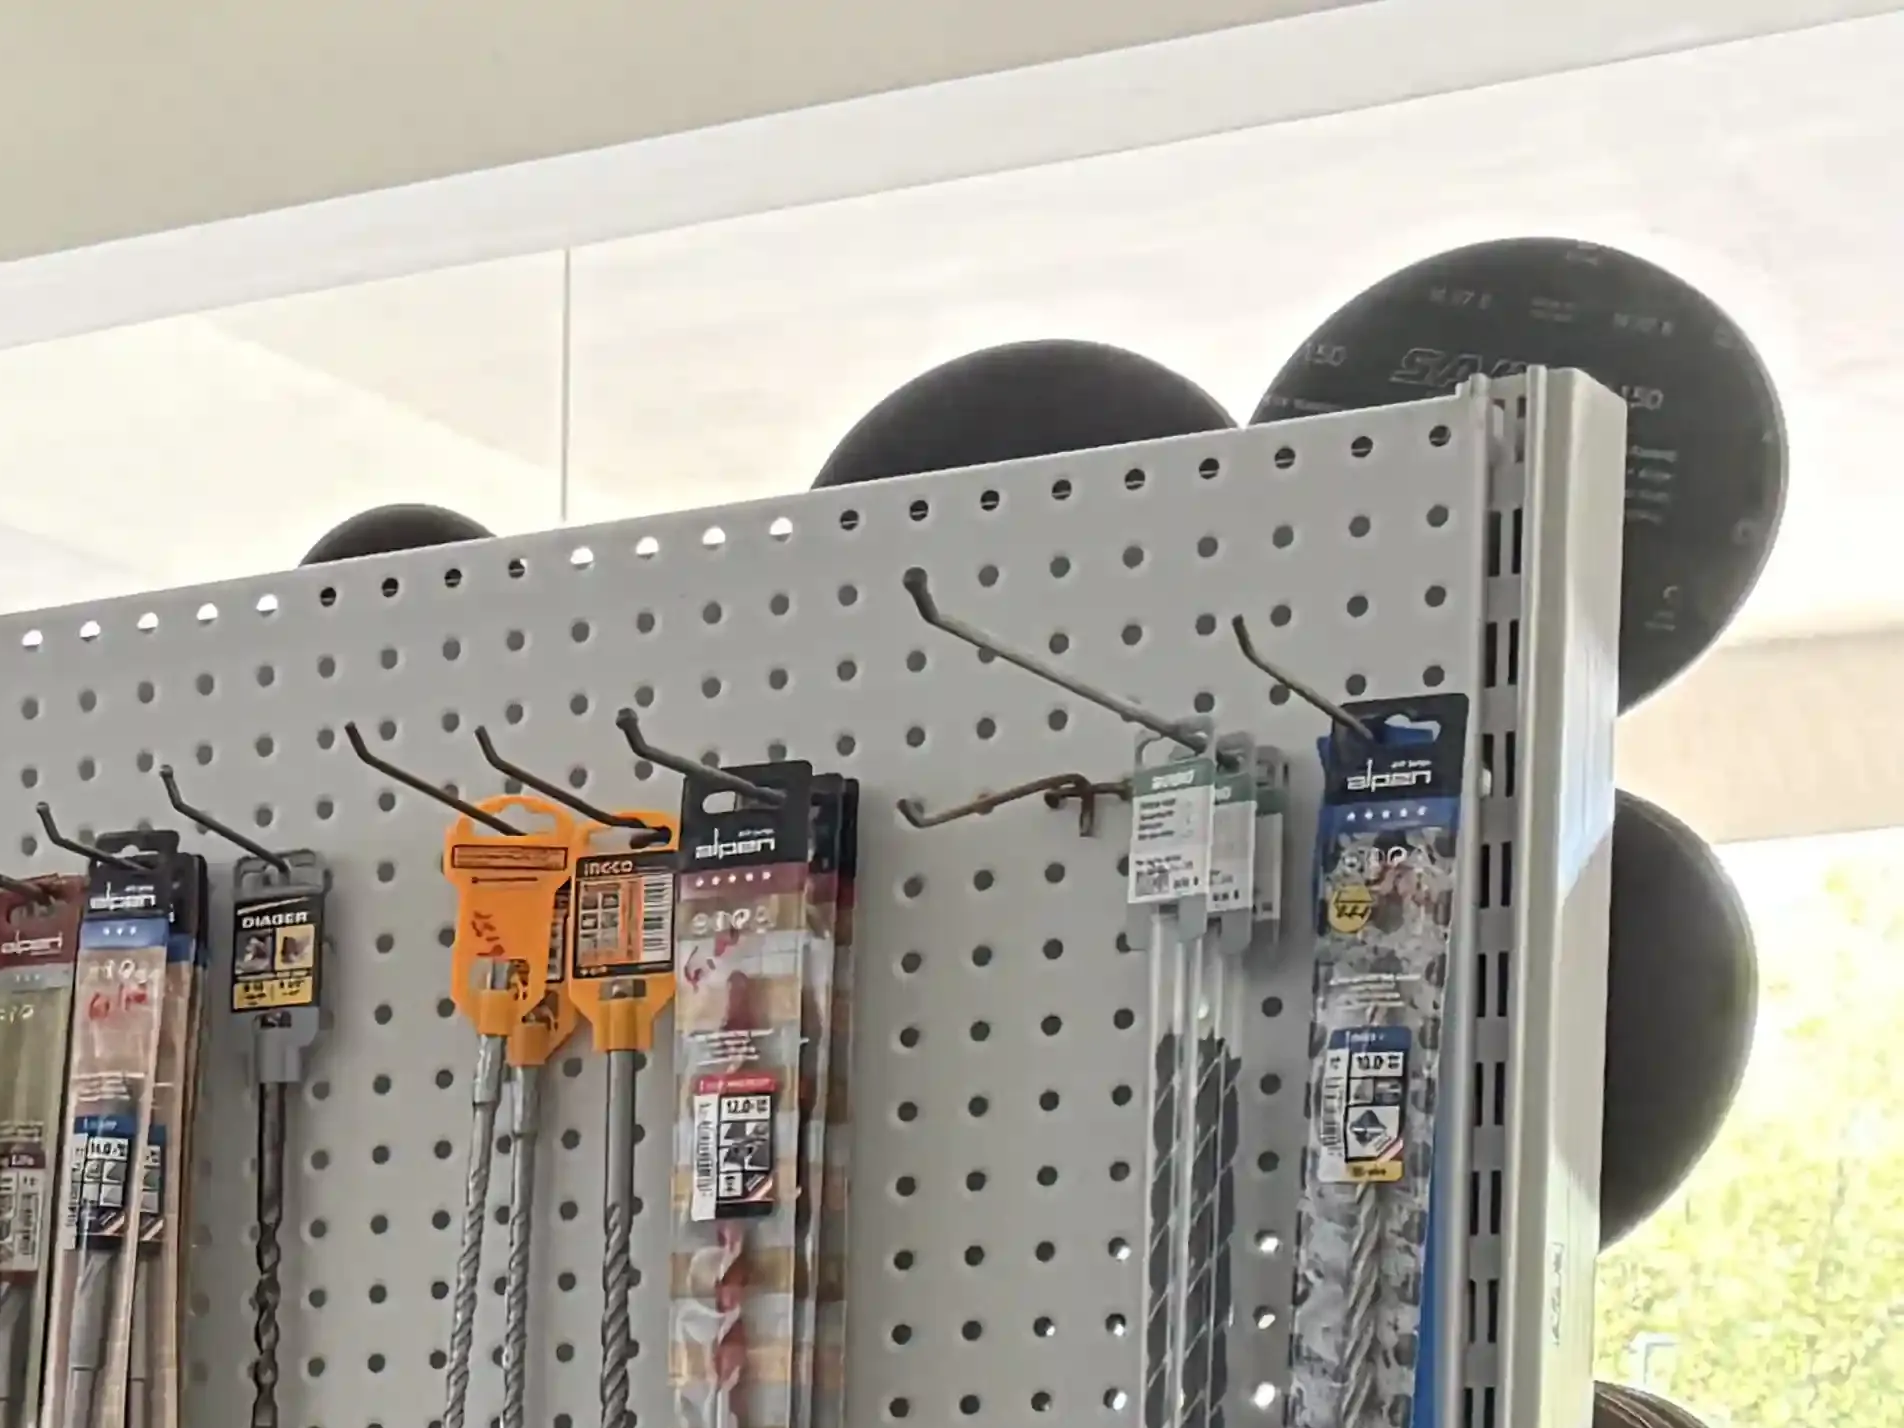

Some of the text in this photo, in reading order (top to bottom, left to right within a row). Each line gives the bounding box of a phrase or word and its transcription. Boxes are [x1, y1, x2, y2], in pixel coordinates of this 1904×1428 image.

[1347, 758, 1432, 792] alpen
[696, 828, 776, 859] alpen
[584, 861, 633, 876] INGCO
[90, 883, 157, 911] alpen
[242, 911, 308, 928] DIAGER
[1, 929, 63, 957] alpen
